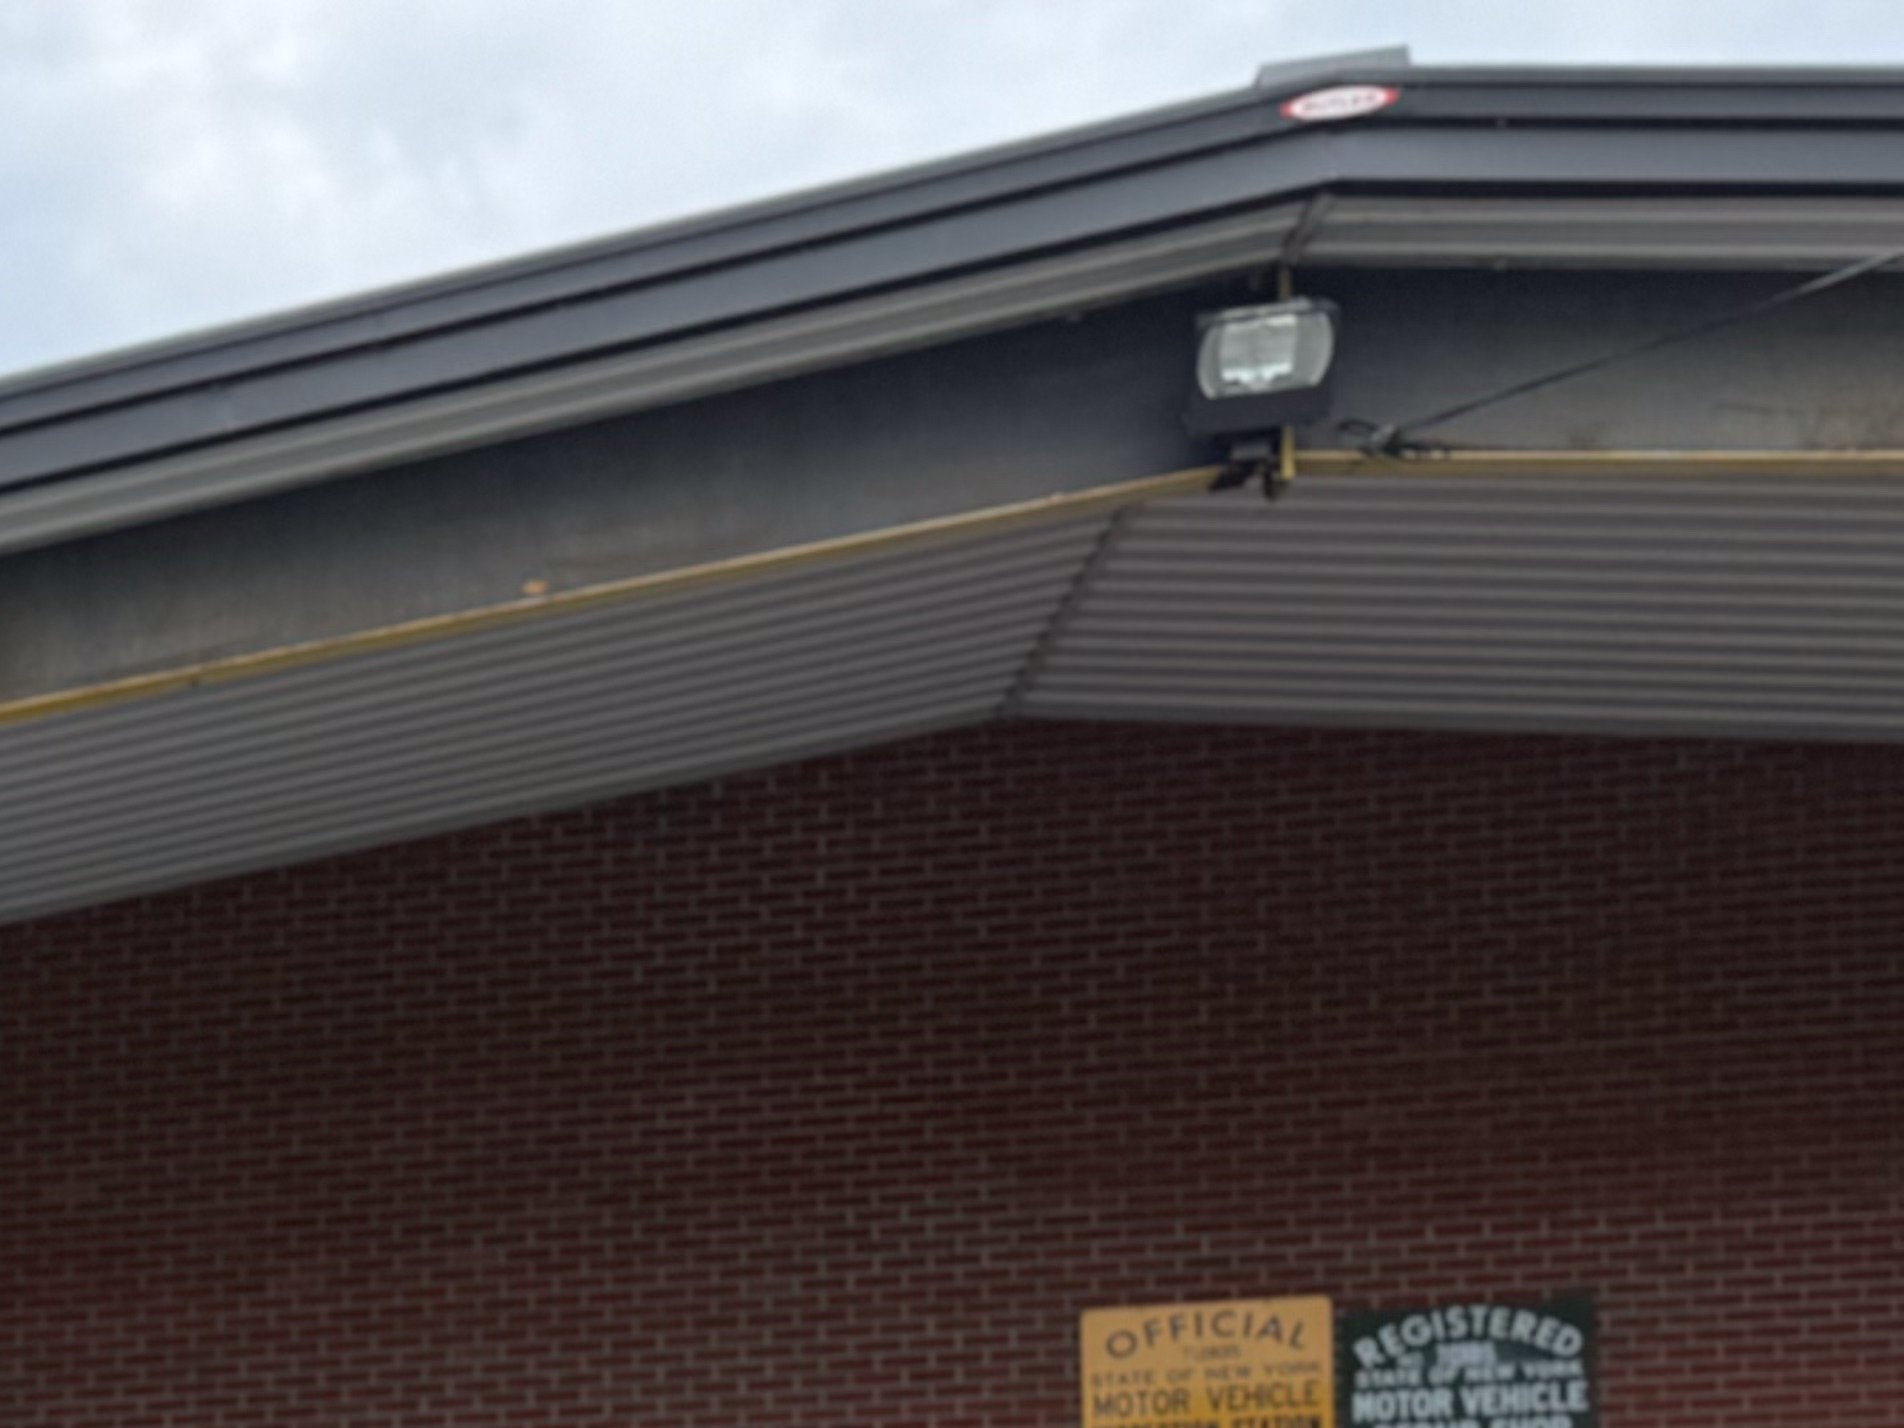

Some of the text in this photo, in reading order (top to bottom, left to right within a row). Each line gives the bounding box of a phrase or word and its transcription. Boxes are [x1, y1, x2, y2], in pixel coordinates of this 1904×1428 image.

[1106, 1308, 1306, 1360] OFFICIAL
[1352, 1304, 1584, 1368] REGISTERED
[1093, 1379, 1320, 1418] MOTOR VEHICLE
[1351, 1379, 1590, 1424] MOTOR VEHICLE
